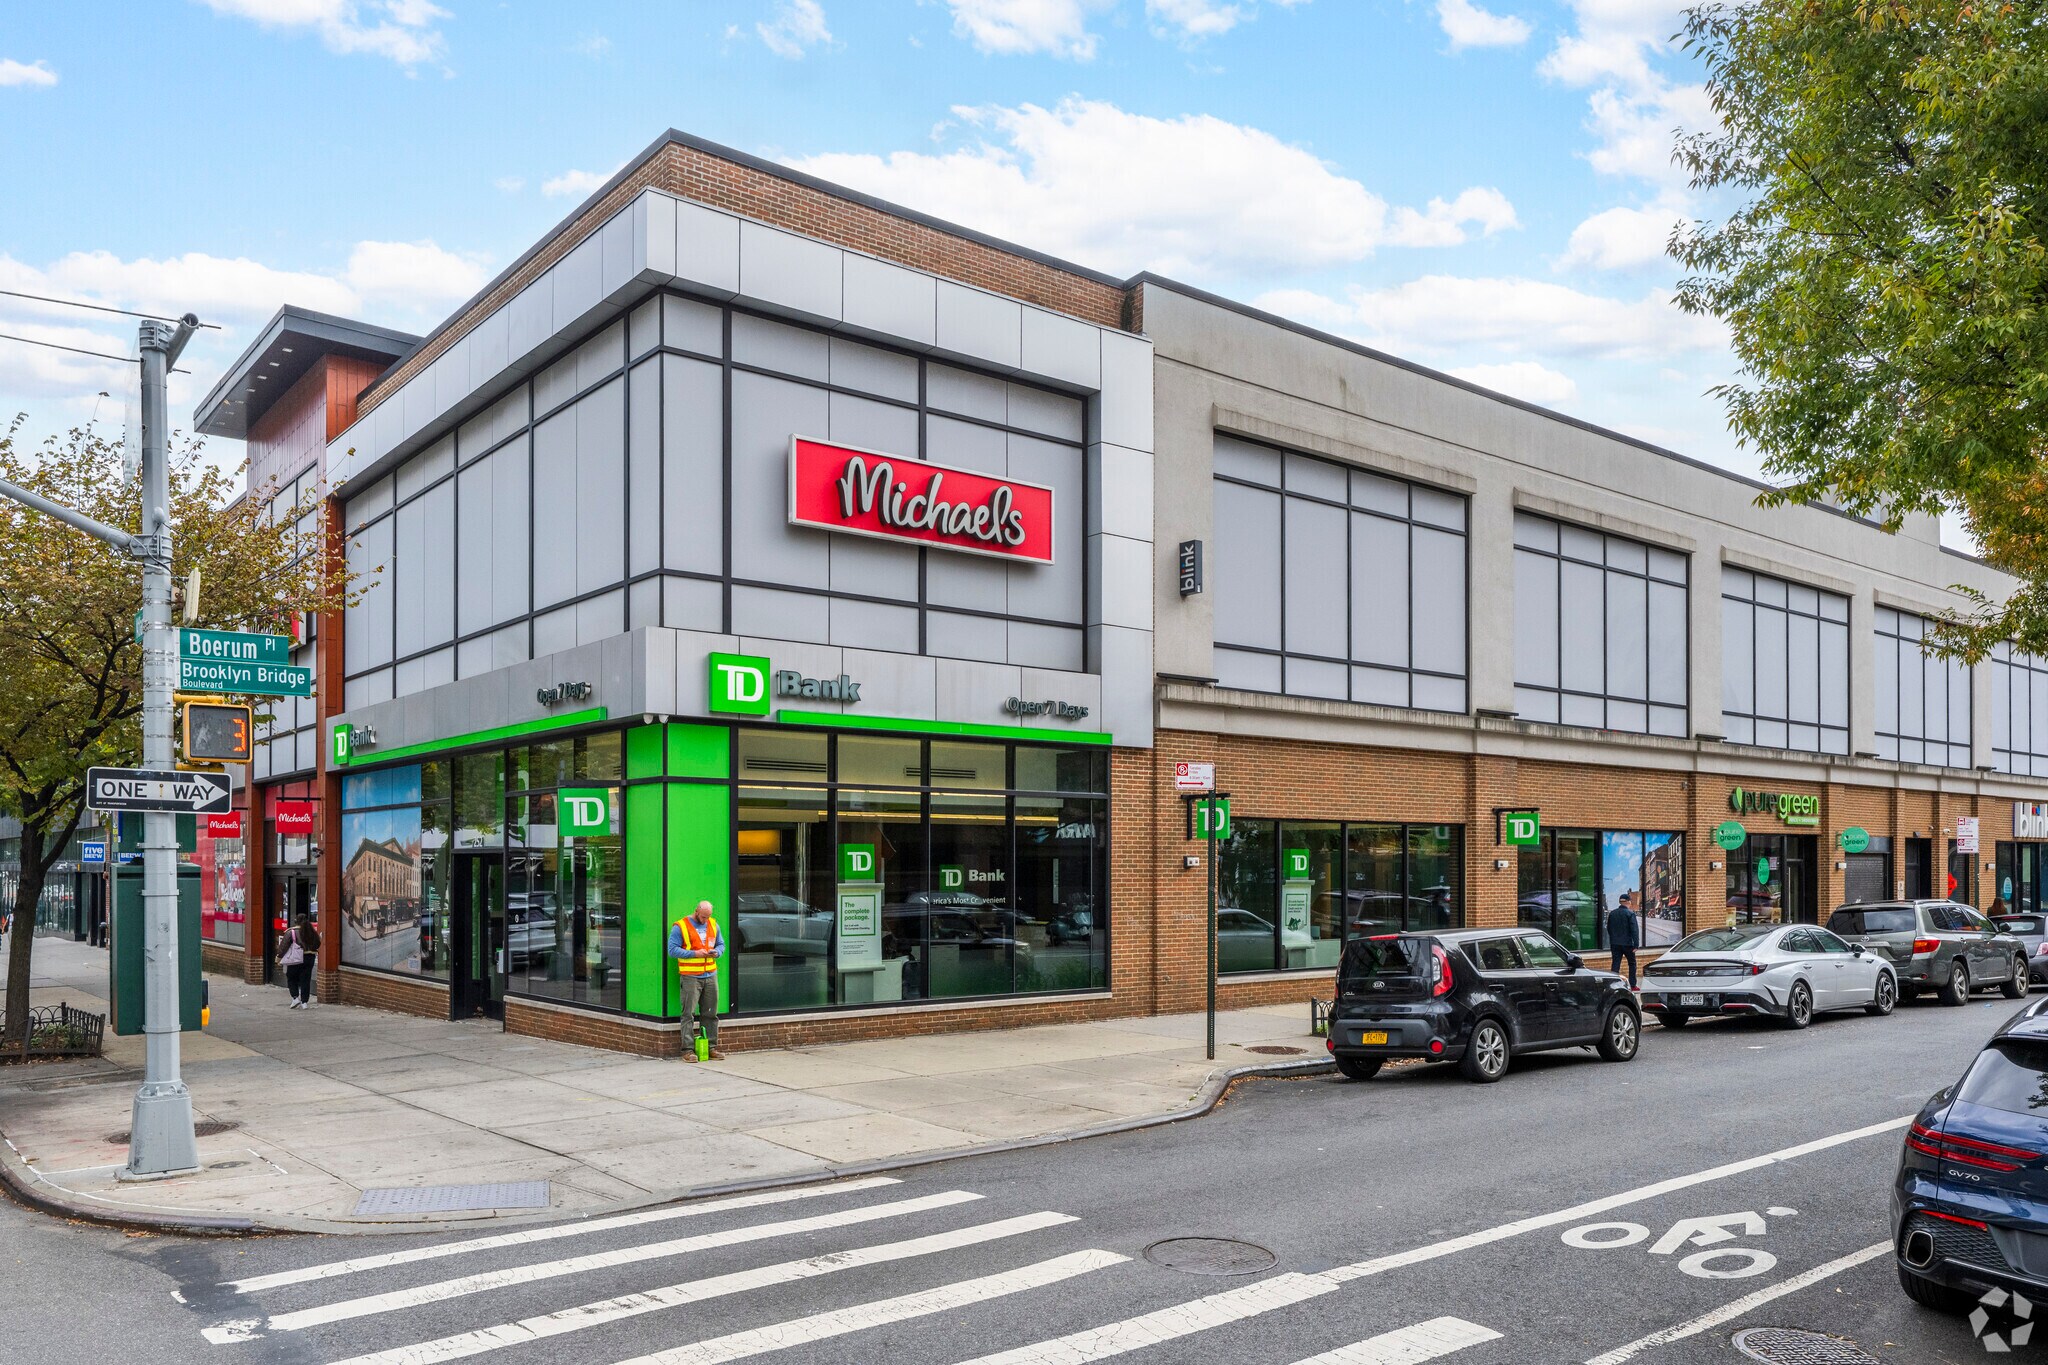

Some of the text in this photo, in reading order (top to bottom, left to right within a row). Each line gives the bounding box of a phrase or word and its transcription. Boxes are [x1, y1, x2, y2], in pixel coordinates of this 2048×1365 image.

[836, 456, 1026, 547] Michaels
[1180, 543, 1195, 592] blink
[189, 632, 276, 660] Boerum Pl
[182, 662, 306, 688] Brooklyn Bridge
[182, 678, 223, 689] Boulevard
[717, 663, 862, 703] TD Bank
[536, 682, 592, 706] Open 7 Days
[1004, 697, 1090, 720] Open 7 Days
[335, 725, 376, 757] TD Bank
[101, 781, 216, 801] ONE WAY
[564, 797, 605, 827] TD
[1740, 791, 1820, 820] pure green
[209, 820, 239, 829] Michaels
[278, 813, 312, 823] Michaels
[1199, 807, 1225, 831] TD
[1509, 818, 1536, 839] TD
[1719, 834, 1742, 842] green
[84, 846, 104, 854] five
[1844, 837, 1866, 846] green
[847, 851, 872, 872] TD
[1291, 854, 1308, 872] TD
[941, 868, 1006, 888] TD Bank
[844, 908, 870, 916] complete
[844, 914, 870, 922] package.
[1372, 981, 1386, 990] KIA
[1948, 1169, 1981, 1182] GV70
